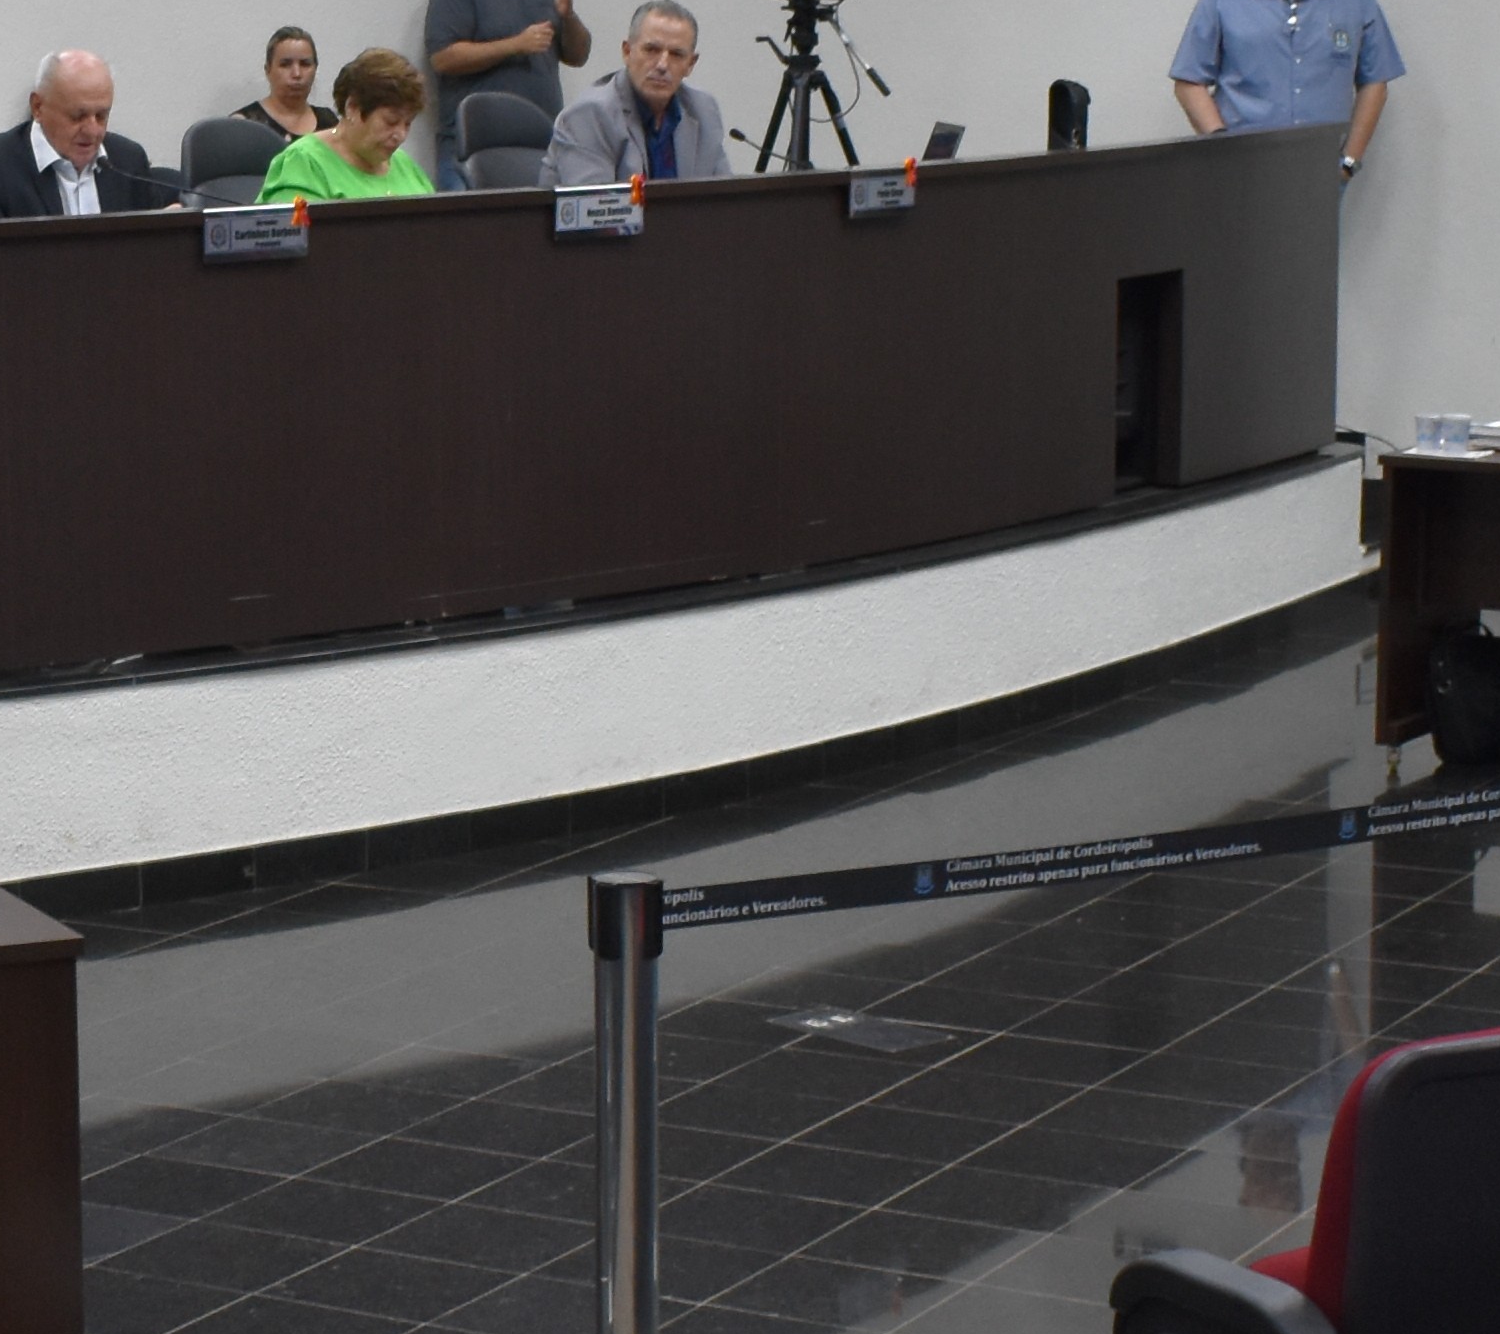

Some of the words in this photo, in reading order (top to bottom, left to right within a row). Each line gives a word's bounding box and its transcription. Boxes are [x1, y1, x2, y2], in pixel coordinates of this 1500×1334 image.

[1367, 802, 1409, 817] Câmara
[1411, 795, 1465, 814] Municipal
[1366, 821, 1404, 836] Acesso
[1406, 815, 1447, 831] restrito
[1449, 809, 1487, 826] apenas
[945, 856, 992, 873] Câmara
[995, 849, 1053, 869] Municipal
[1055, 846, 1072, 860] de
[1073, 837, 1153, 859] Cordeirópolis
[945, 877, 988, 892] Acesso
[989, 870, 1035, 888] restrito
[1036, 866, 1080, 884] apenas
[1081, 862, 1108, 880] para
[1110, 853, 1184, 872] funcionários
[1185, 853, 1194, 862] e
[662, 905, 739, 925] uncionários
[741, 906, 750, 915] e
[752, 895, 827, 915] Vereadores.
